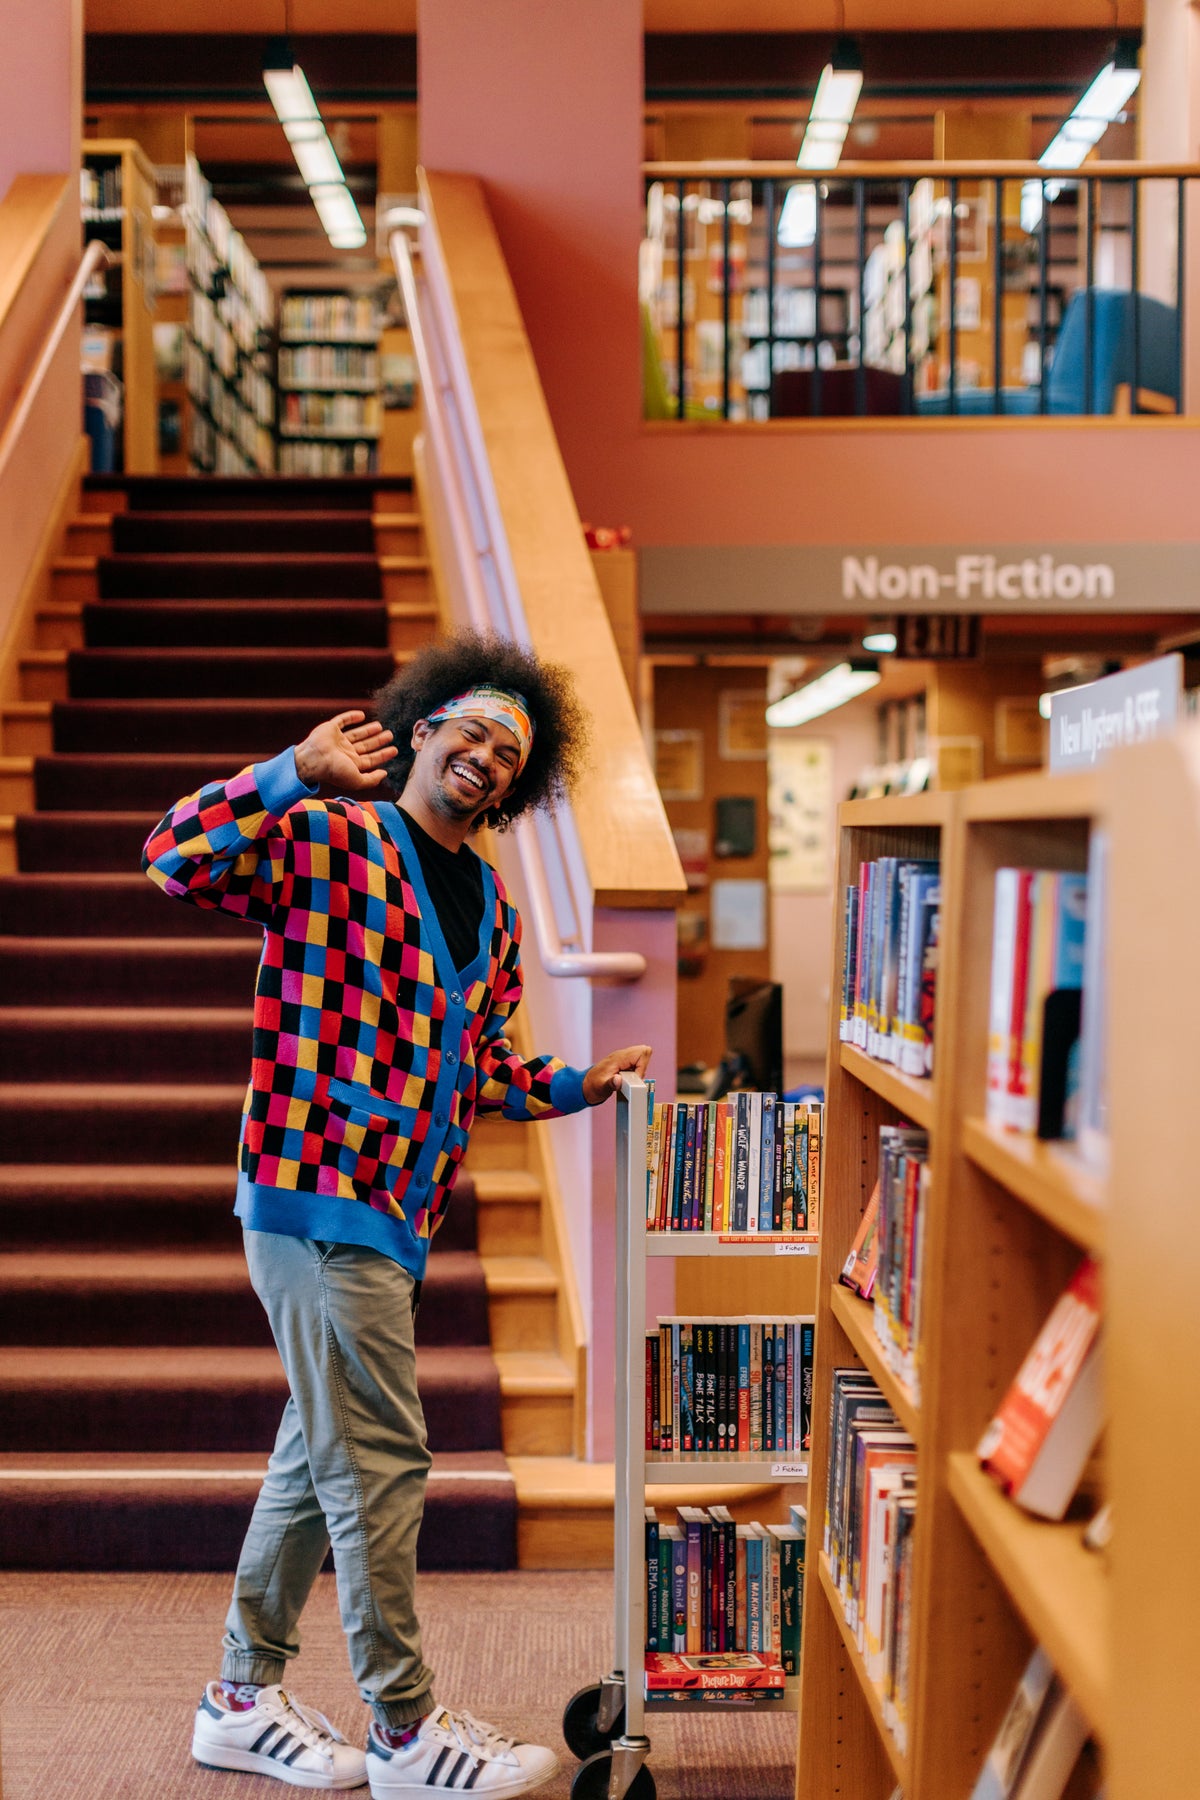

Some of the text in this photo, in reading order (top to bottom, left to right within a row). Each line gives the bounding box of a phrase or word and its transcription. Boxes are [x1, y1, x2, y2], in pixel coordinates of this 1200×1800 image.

[842, 554, 1114, 599] Non-Fiction
[738, 1129, 748, 1149] WOLF
[736, 1161, 747, 1190] WANDER
[683, 1180, 692, 1205] Within
[810, 1196, 818, 1214] Here
[740, 1366, 748, 1387] EFRÉN
[751, 1370, 762, 1384] 90
[803, 1367, 812, 1405] Unplugged
[696, 1372, 704, 1423] BONE TALK
[706, 1373, 715, 1424] BONE TALK
[649, 1558, 658, 1590] REMA
[676, 1579, 684, 1608] timid
[690, 1572, 699, 1627] DUEL
[751, 1582, 759, 1618] MAKING
[751, 1620, 759, 1653] FRIEND
[701, 1674, 746, 1688] Picture Day
